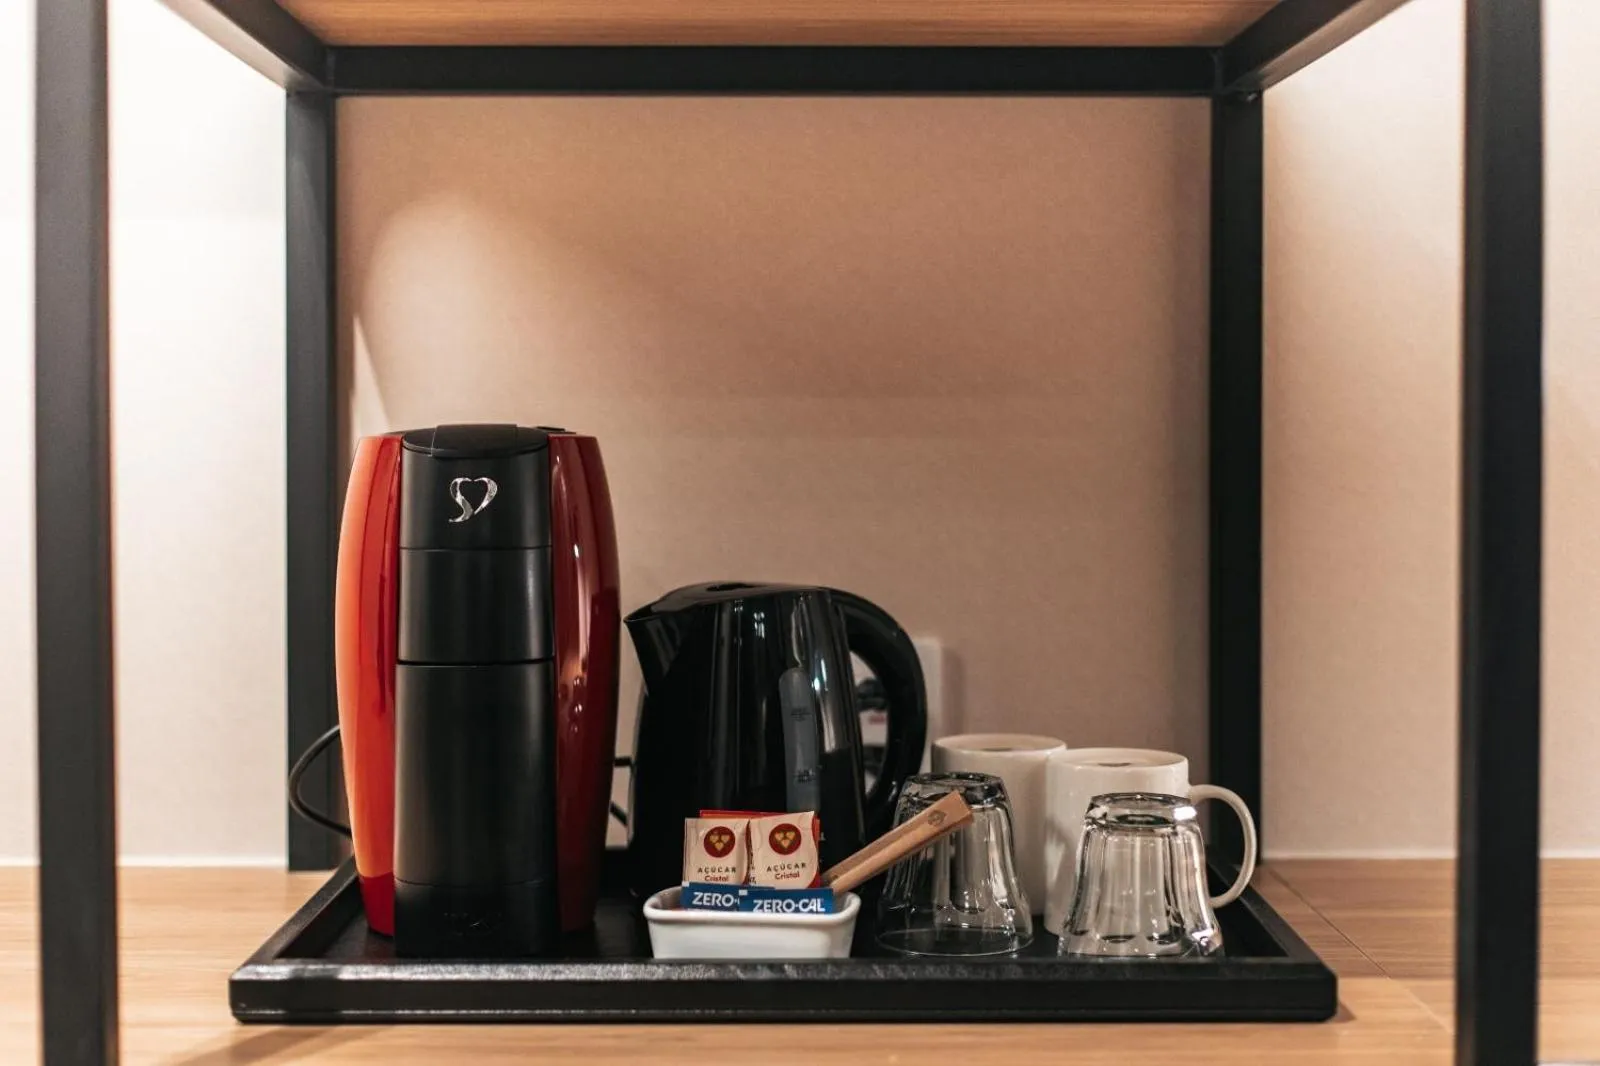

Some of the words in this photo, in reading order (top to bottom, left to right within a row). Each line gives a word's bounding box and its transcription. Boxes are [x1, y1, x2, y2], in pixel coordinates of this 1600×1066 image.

[766, 862, 806, 872] AÇÚCAR
[775, 870, 800, 880] Cristal
[692, 891, 740, 907] ZERO-
[752, 898, 826, 913] ZERO-CAL
